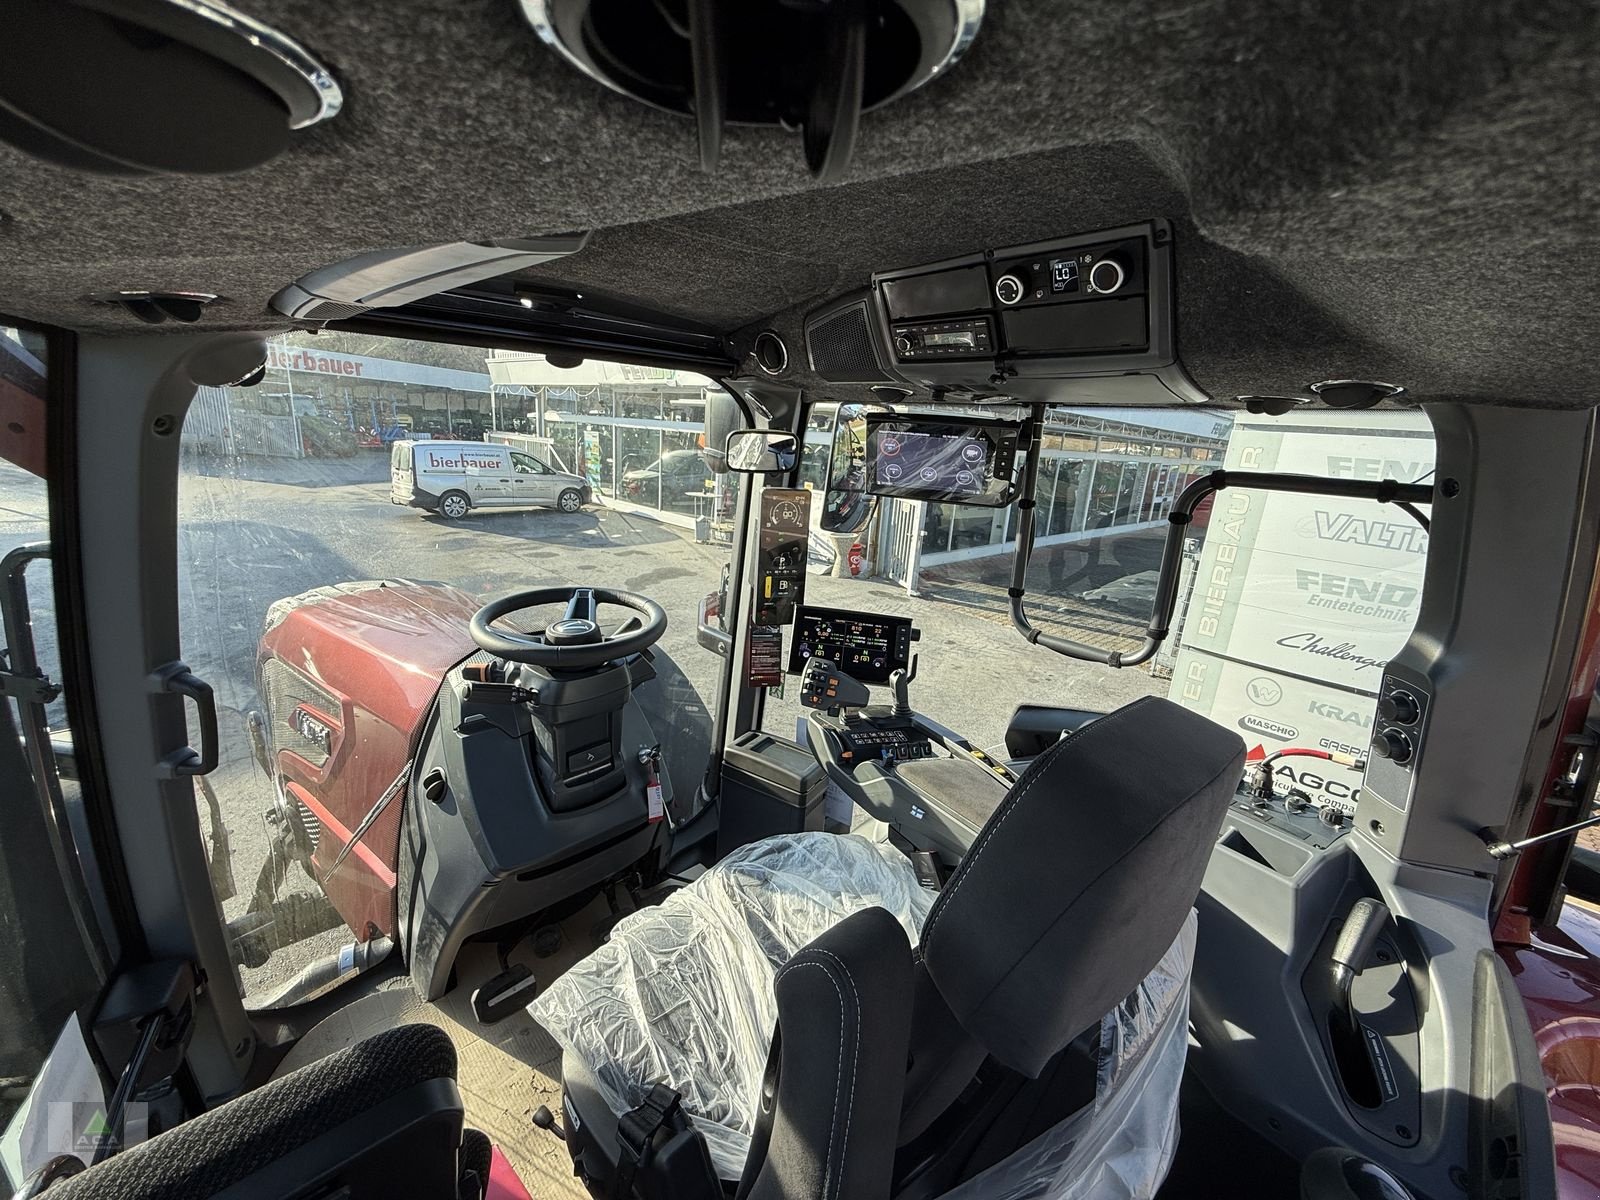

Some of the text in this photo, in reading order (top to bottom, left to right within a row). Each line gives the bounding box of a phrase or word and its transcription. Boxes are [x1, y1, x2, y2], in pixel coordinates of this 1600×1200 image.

[267, 345, 363, 376] ierbauer
[429, 452, 502, 469] bierbauer
[1198, 446, 1264, 638] BIERBAUR
[1307, 594, 1412, 622] Erntetechnik
[1182, 660, 1208, 702] ER
[1247, 717, 1296, 738] MASCHIO
